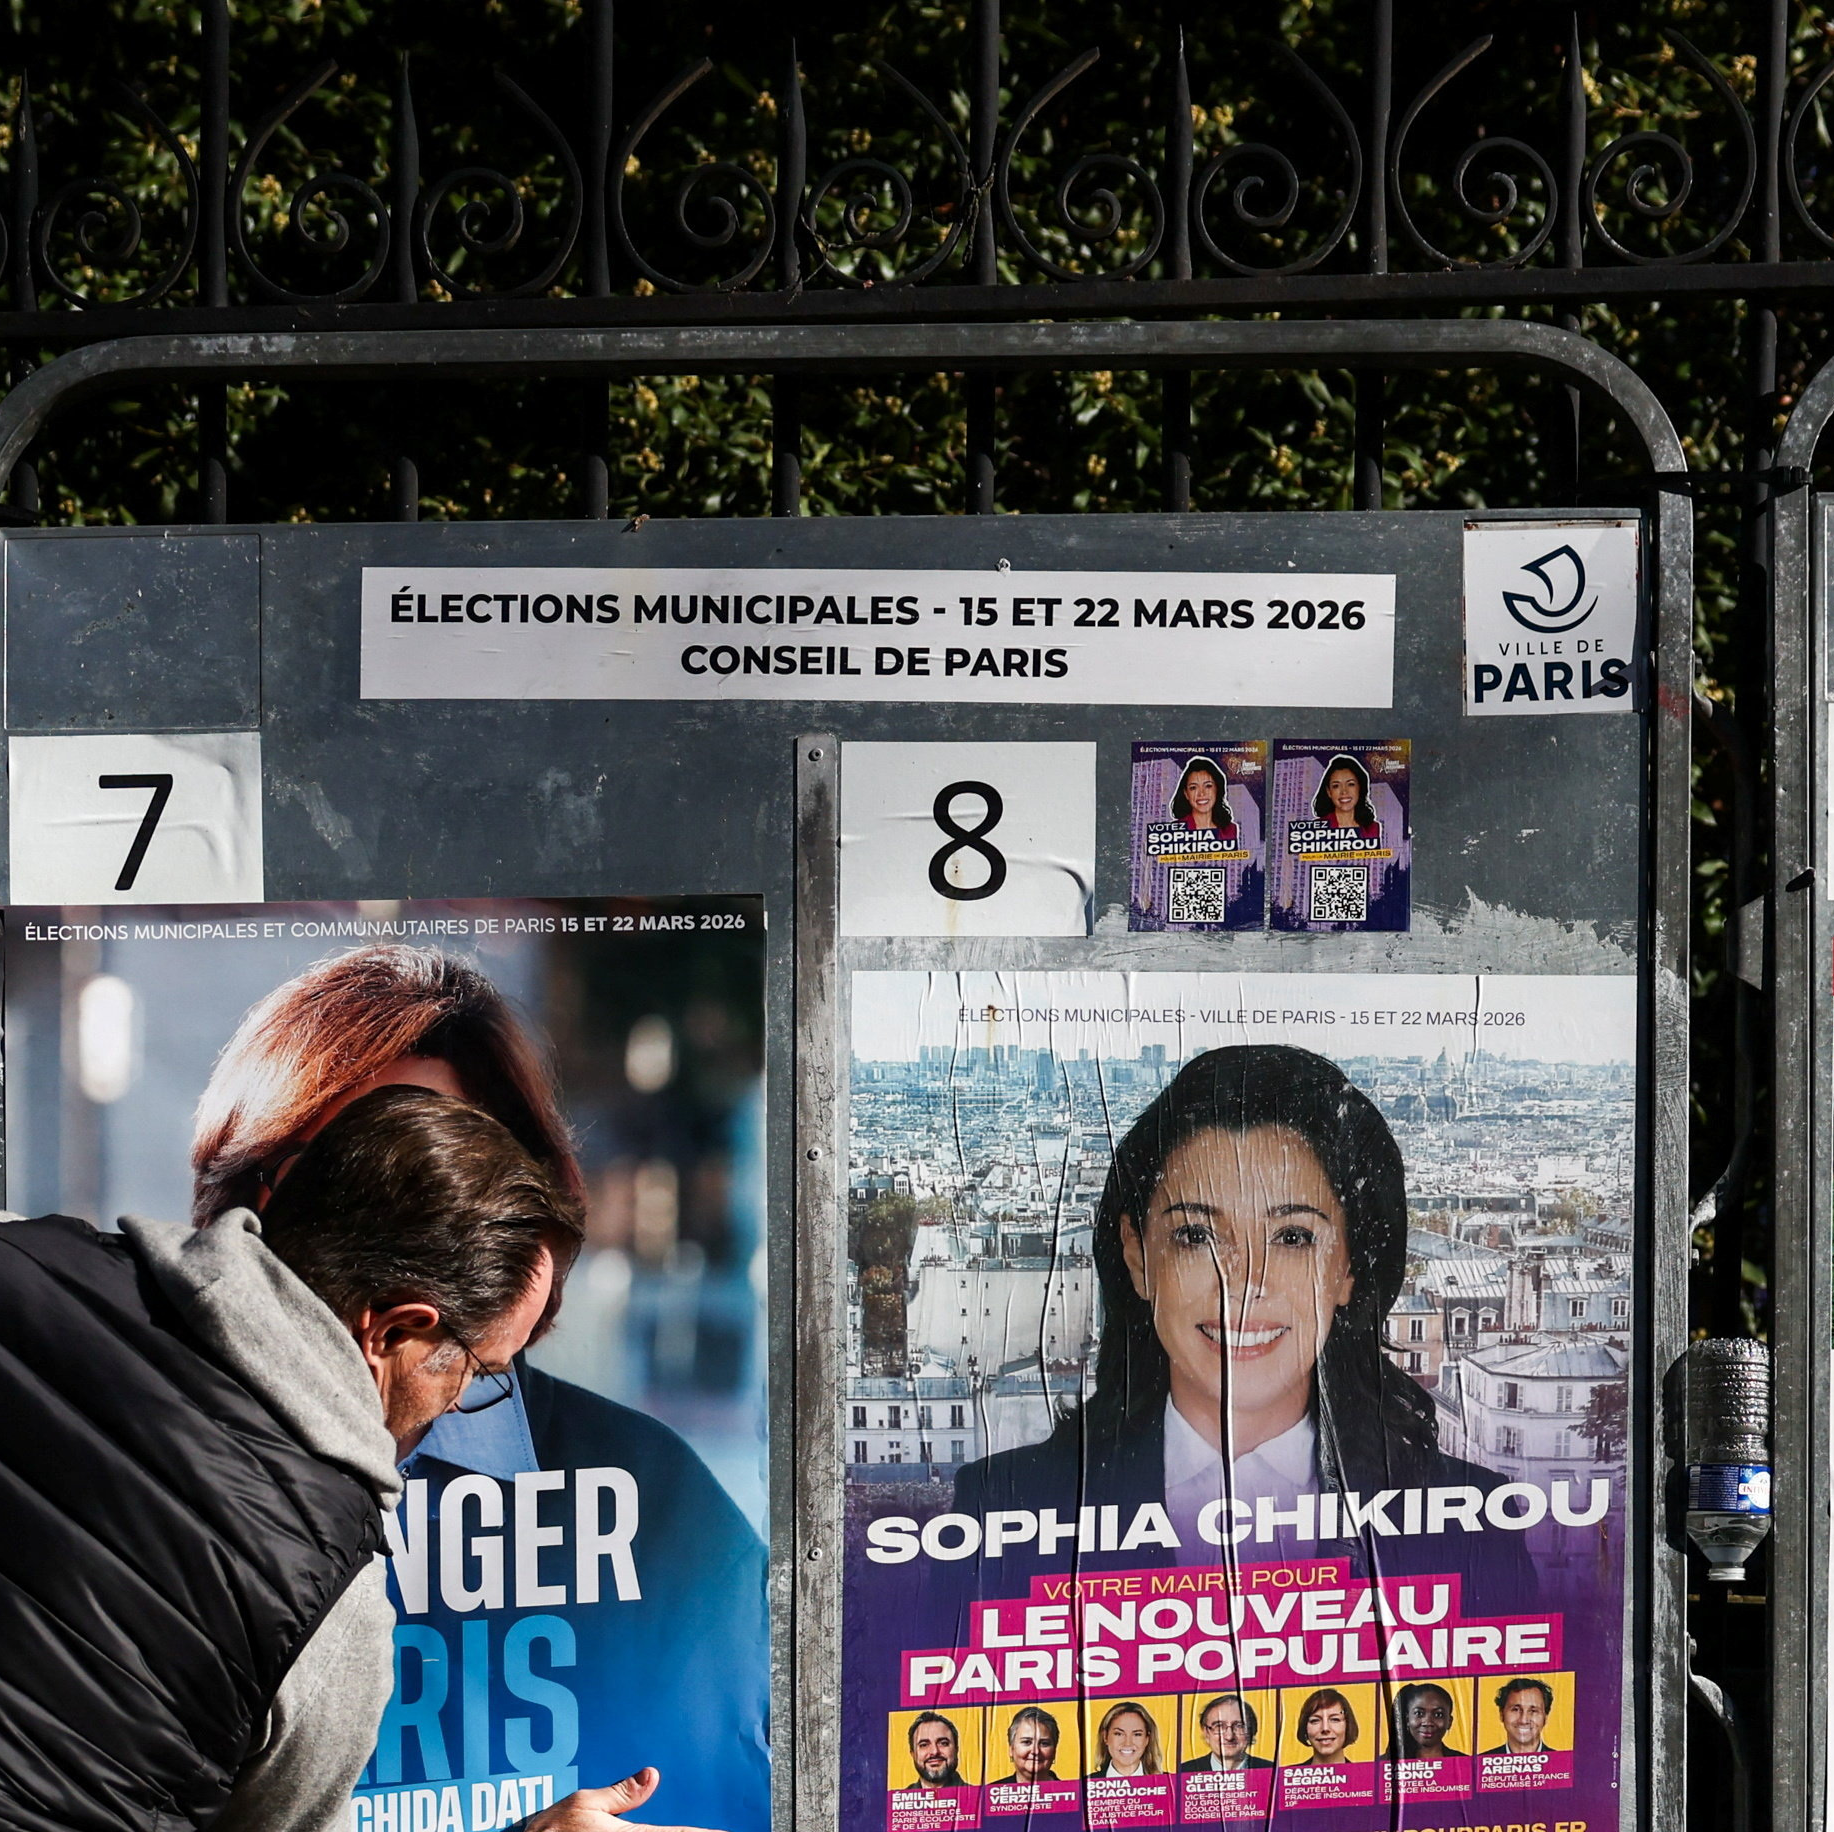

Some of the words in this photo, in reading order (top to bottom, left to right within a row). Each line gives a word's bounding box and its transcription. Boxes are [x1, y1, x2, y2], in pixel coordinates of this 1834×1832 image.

[391, 586, 620, 623] ÉLECTIONS
[634, 595, 919, 625] MUNICIPALES
[959, 597, 998, 626] 15
[1013, 598, 1062, 626] ET
[1074, 598, 1119, 627] 22
[1134, 599, 1254, 629] MARS
[1267, 600, 1365, 630] 2026
[1499, 641, 1562, 656] VILLE
[1577, 639, 1604, 653] DE
[681, 645, 861, 675] CONSEIL
[875, 647, 930, 675] DE
[945, 648, 1068, 678] PARIS
[1474, 659, 1632, 703] PARIS
[99, 774, 173, 890] 7
[1148, 823, 1186, 831] VOTEZ
[1148, 830, 1215, 843] SOPHIA
[929, 781, 1006, 900] 8
[1148, 840, 1236, 854] CHIKIROU
[25, 921, 128, 941] ÉLECTIONS
[135, 922, 258, 940] MUNICIPALES
[264, 923, 285, 938] ET
[291, 919, 469, 938] COMMUNAUTAIRES
[475, 919, 498, 934] DE
[505, 918, 555, 933] PARIS
[561, 917, 578, 932] 15
[585, 917, 607, 932] ET
[612, 916, 634, 932] 22
[640, 915, 695, 931] MARS
[700, 914, 746, 930] 2026
[866, 1502, 1182, 1563] SOPHIA
[1197, 1479, 1609, 1545] CHIKIROU
[381, 1467, 642, 1615] NGER
[1043, 1577, 1142, 1600] VOTRE
[1151, 1571, 1242, 1594] MAIRE
[1252, 1566, 1338, 1588] POUR
[982, 1604, 1069, 1648] LE
[1084, 1584, 1449, 1643] NOUVEAU
[910, 1648, 1121, 1697] PARIS
[1137, 1623, 1550, 1685] POPULAIRE
[357, 1614, 579, 1785] RIS
[1482, 1755, 1549, 1766] RODRIGO
[1482, 1764, 1542, 1775] ARENAS
[1283, 1767, 1335, 1778] SARAH
[1283, 1775, 1347, 1786] LEGRAIN
[892, 1791, 935, 1802] ÉMILE
[989, 1784, 1040, 1796] CÉLINE
[989, 1792, 1076, 1805] VERZELETTI
[892, 1799, 957, 1810] MEUNIER
